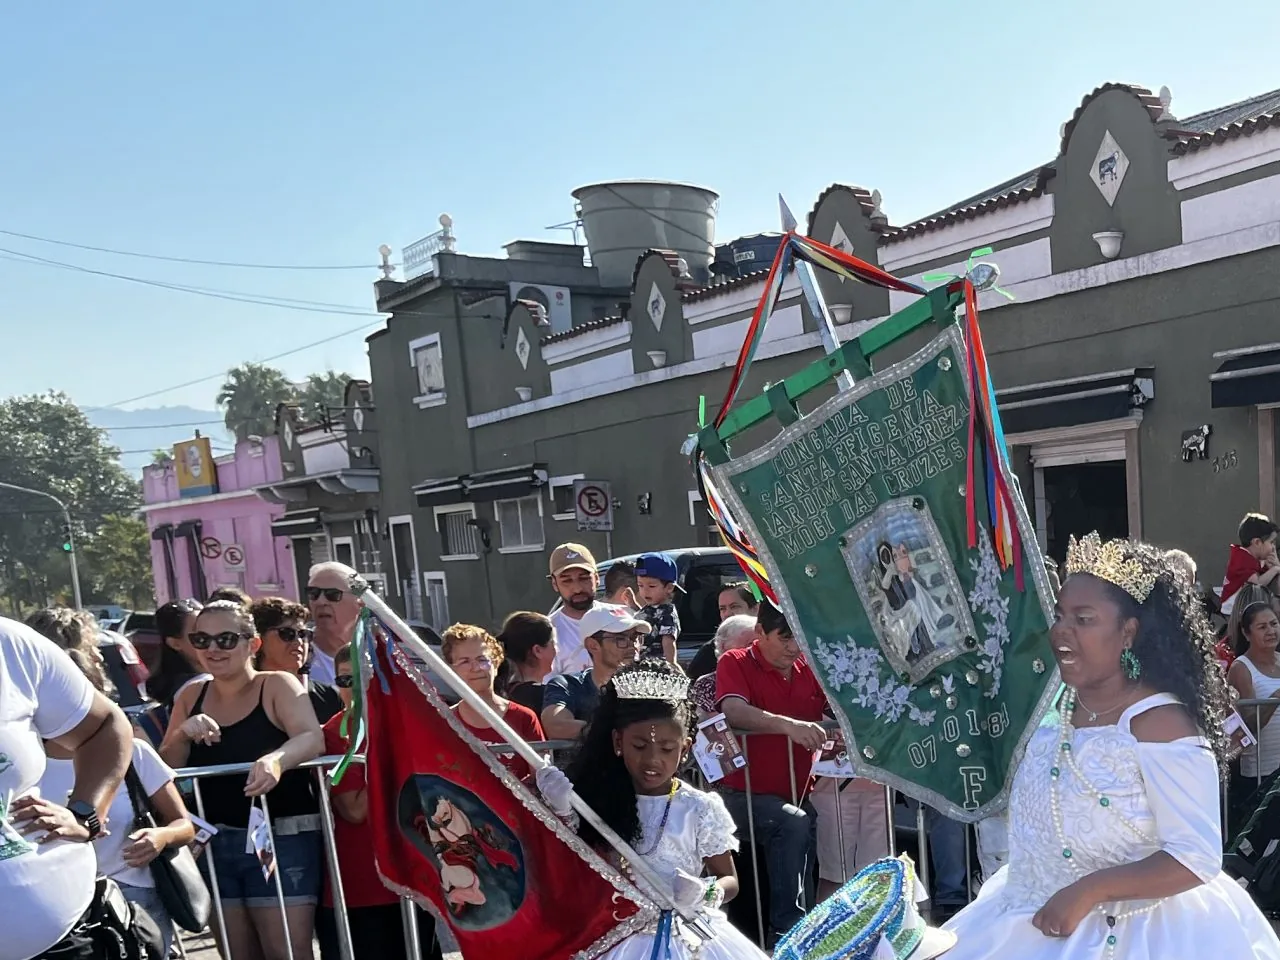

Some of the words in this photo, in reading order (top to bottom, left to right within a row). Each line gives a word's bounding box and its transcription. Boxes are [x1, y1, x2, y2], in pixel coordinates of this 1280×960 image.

[761, 455, 836, 514] SANTA
[832, 389, 945, 469] EFIGENIA
[772, 402, 869, 477] CONGADA
[883, 376, 918, 410] DE
[838, 443, 906, 493] SANTA
[780, 510, 836, 561] MOGI
[840, 484, 878, 524] DAS
[882, 436, 967, 495] CRUZES
[959, 766, 986, 811] F
